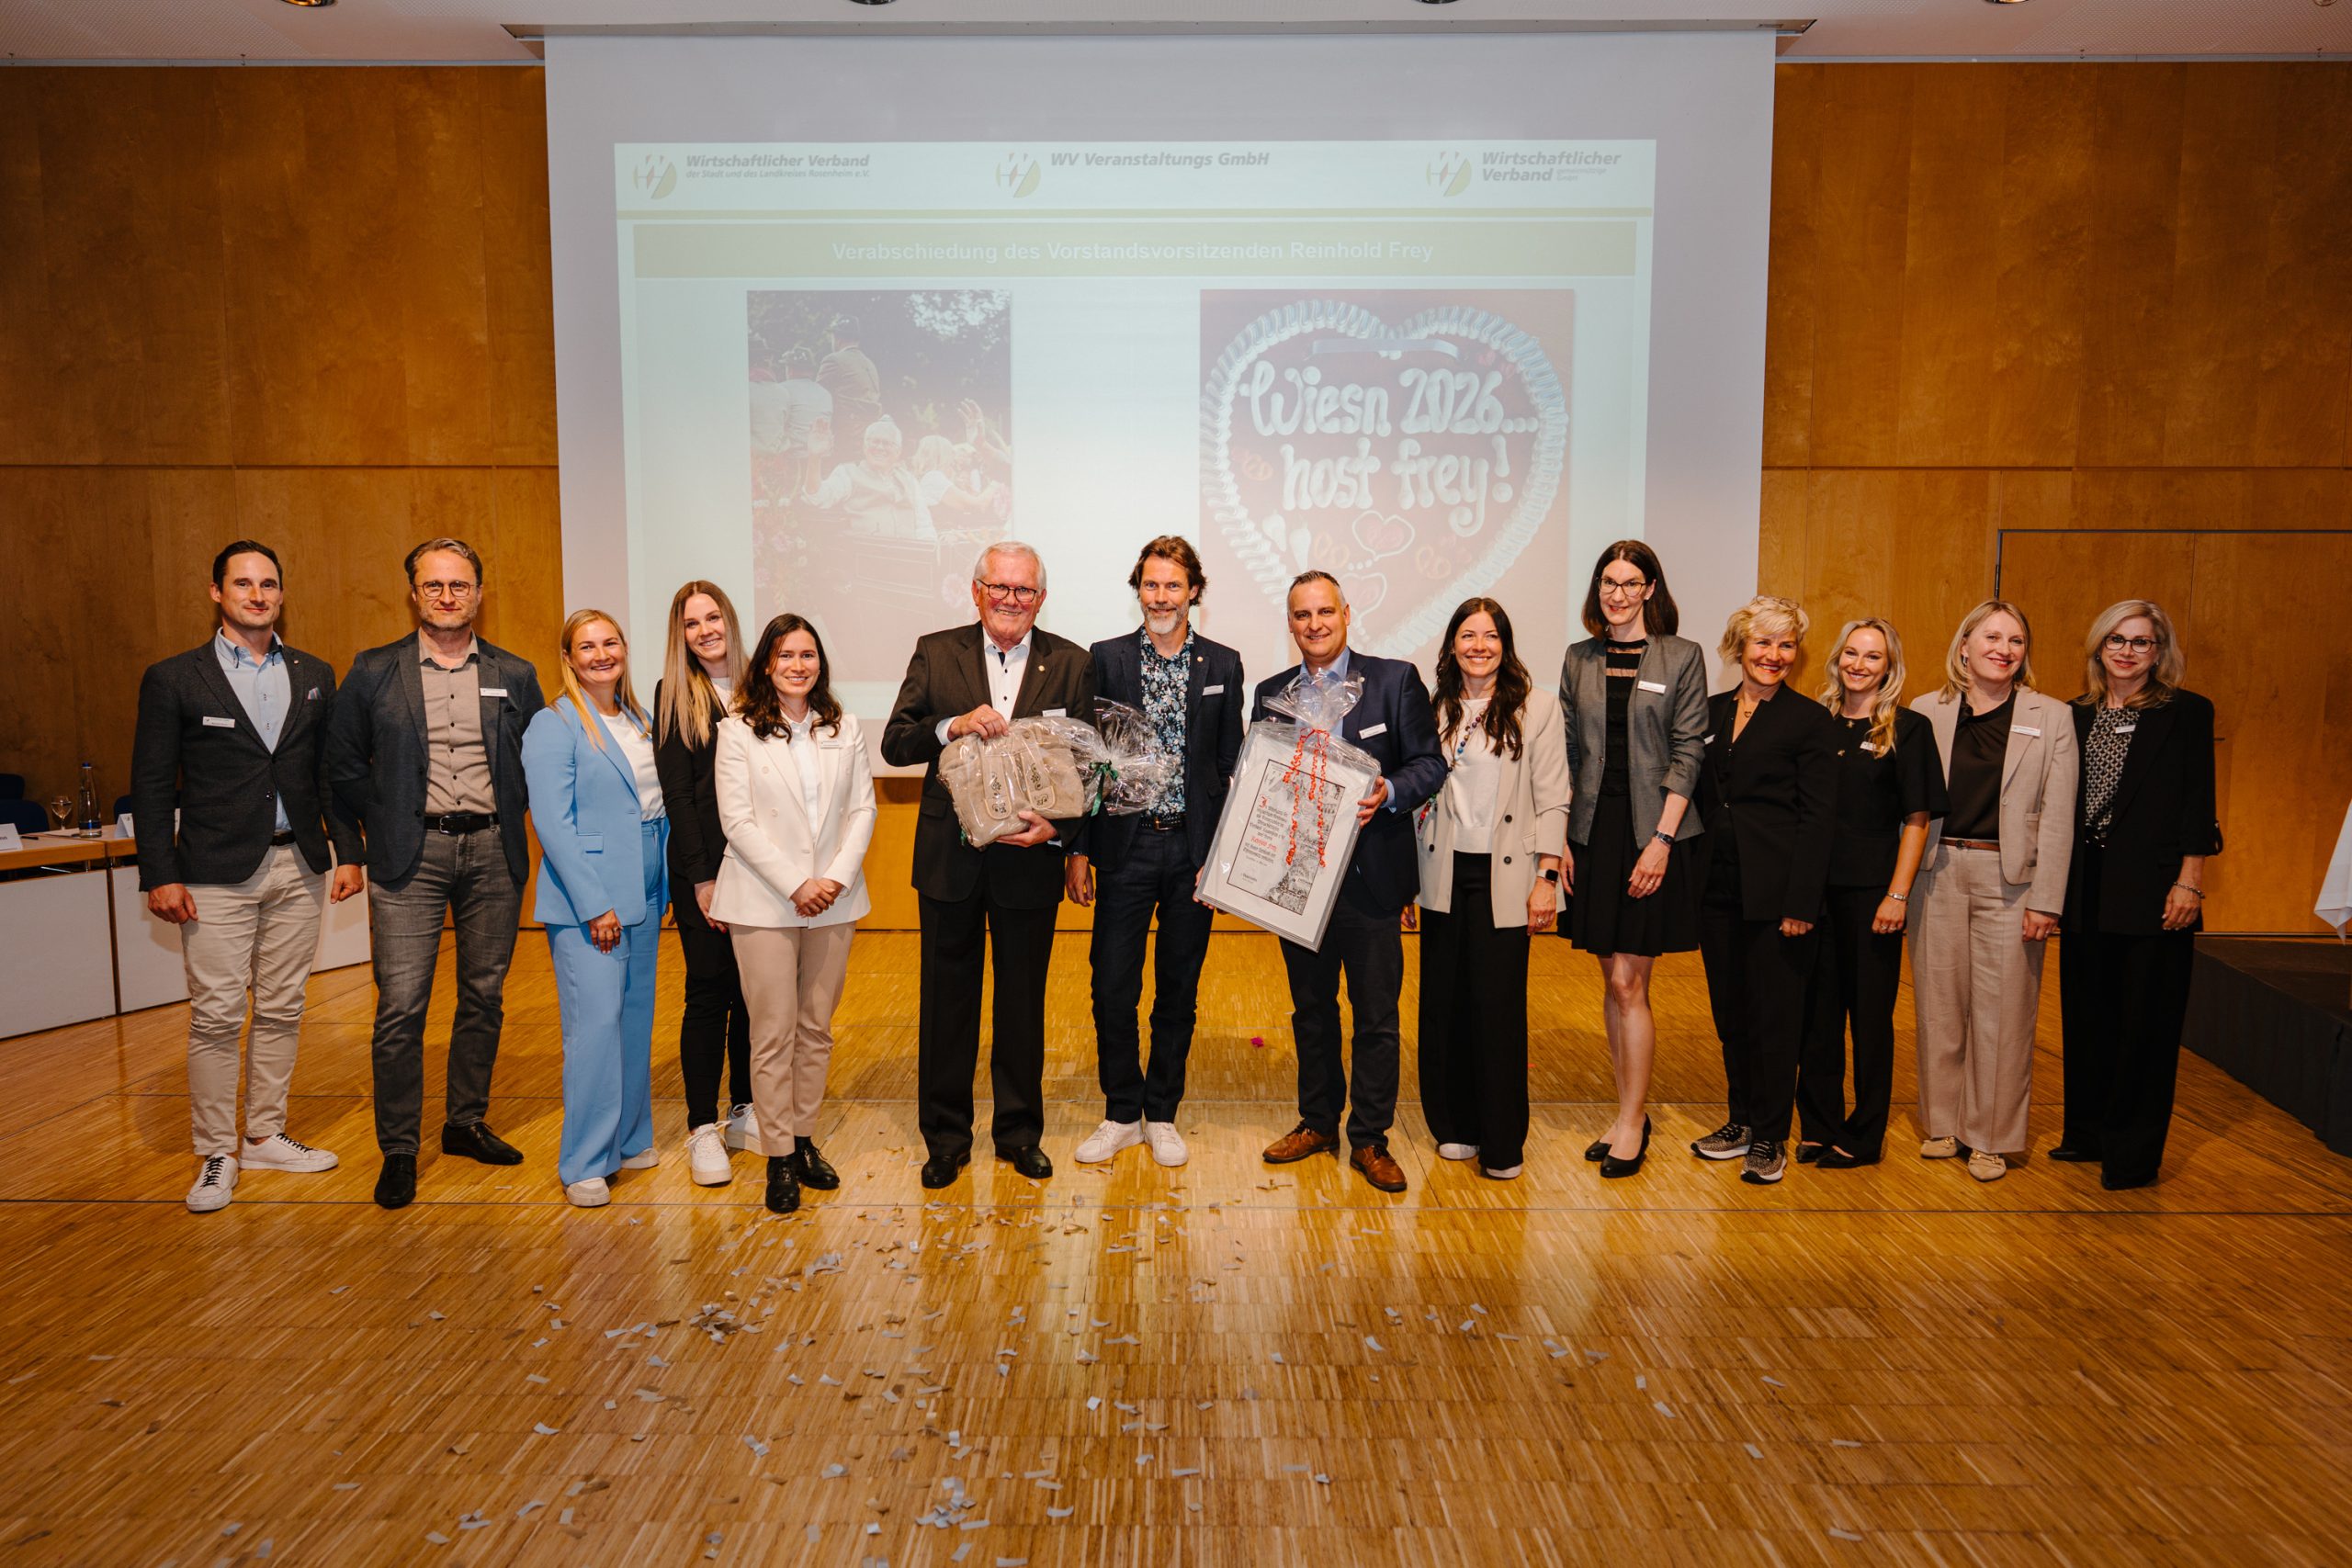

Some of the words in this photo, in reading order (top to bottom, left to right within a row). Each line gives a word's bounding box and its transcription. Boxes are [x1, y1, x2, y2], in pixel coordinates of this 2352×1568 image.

[686, 153, 804, 167] Wirtschaftlicher
[808, 153, 870, 167] Verband
[1050, 152, 1080, 166] WV
[1085, 151, 1213, 169] Veranstaltungs
[1217, 152, 1271, 166] GmbH
[1482, 151, 1622, 166] Wirtschaftlicher
[1482, 167, 1554, 182] Verband
[832, 242, 997, 264] Verabschiedung
[1005, 243, 1041, 260] des
[1046, 242, 1283, 260] Vorstandsvorsitzenden
[1290, 242, 1382, 259] Reinhold
[1389, 242, 1433, 263] Frey
[1238, 360, 1391, 437] Wiesn
[1280, 436, 1381, 511] host
[1390, 434, 1514, 537] frey!
